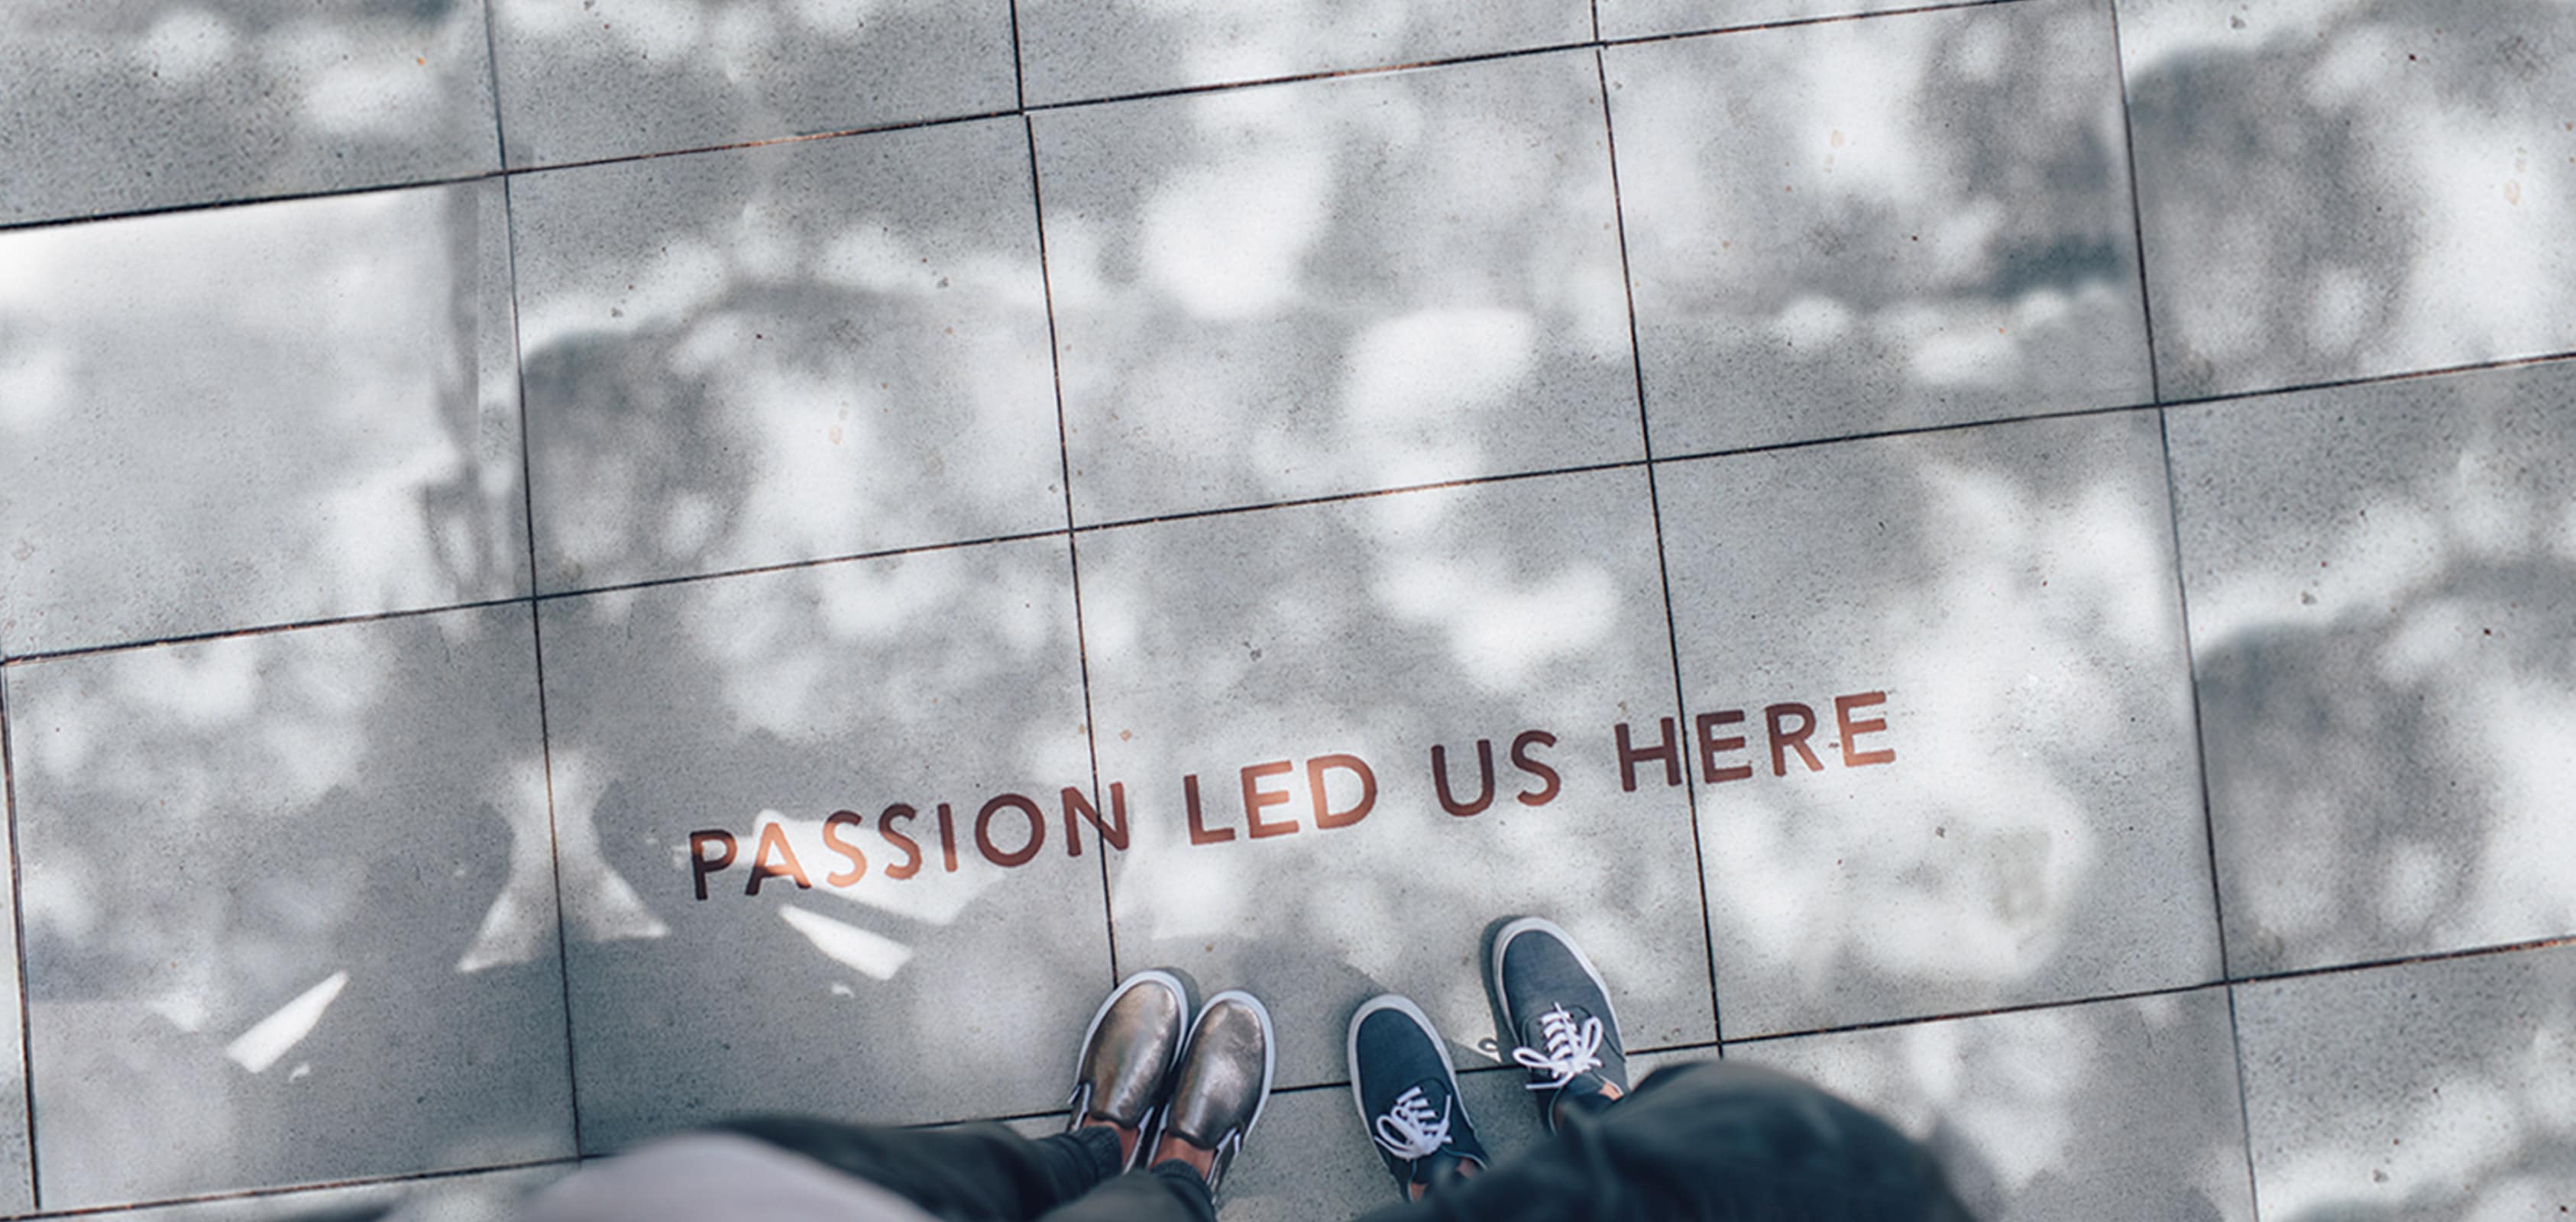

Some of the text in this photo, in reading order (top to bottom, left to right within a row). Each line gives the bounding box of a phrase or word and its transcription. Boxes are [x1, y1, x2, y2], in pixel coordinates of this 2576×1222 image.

[690, 690, 1896, 901] PASSION LED US HERE
